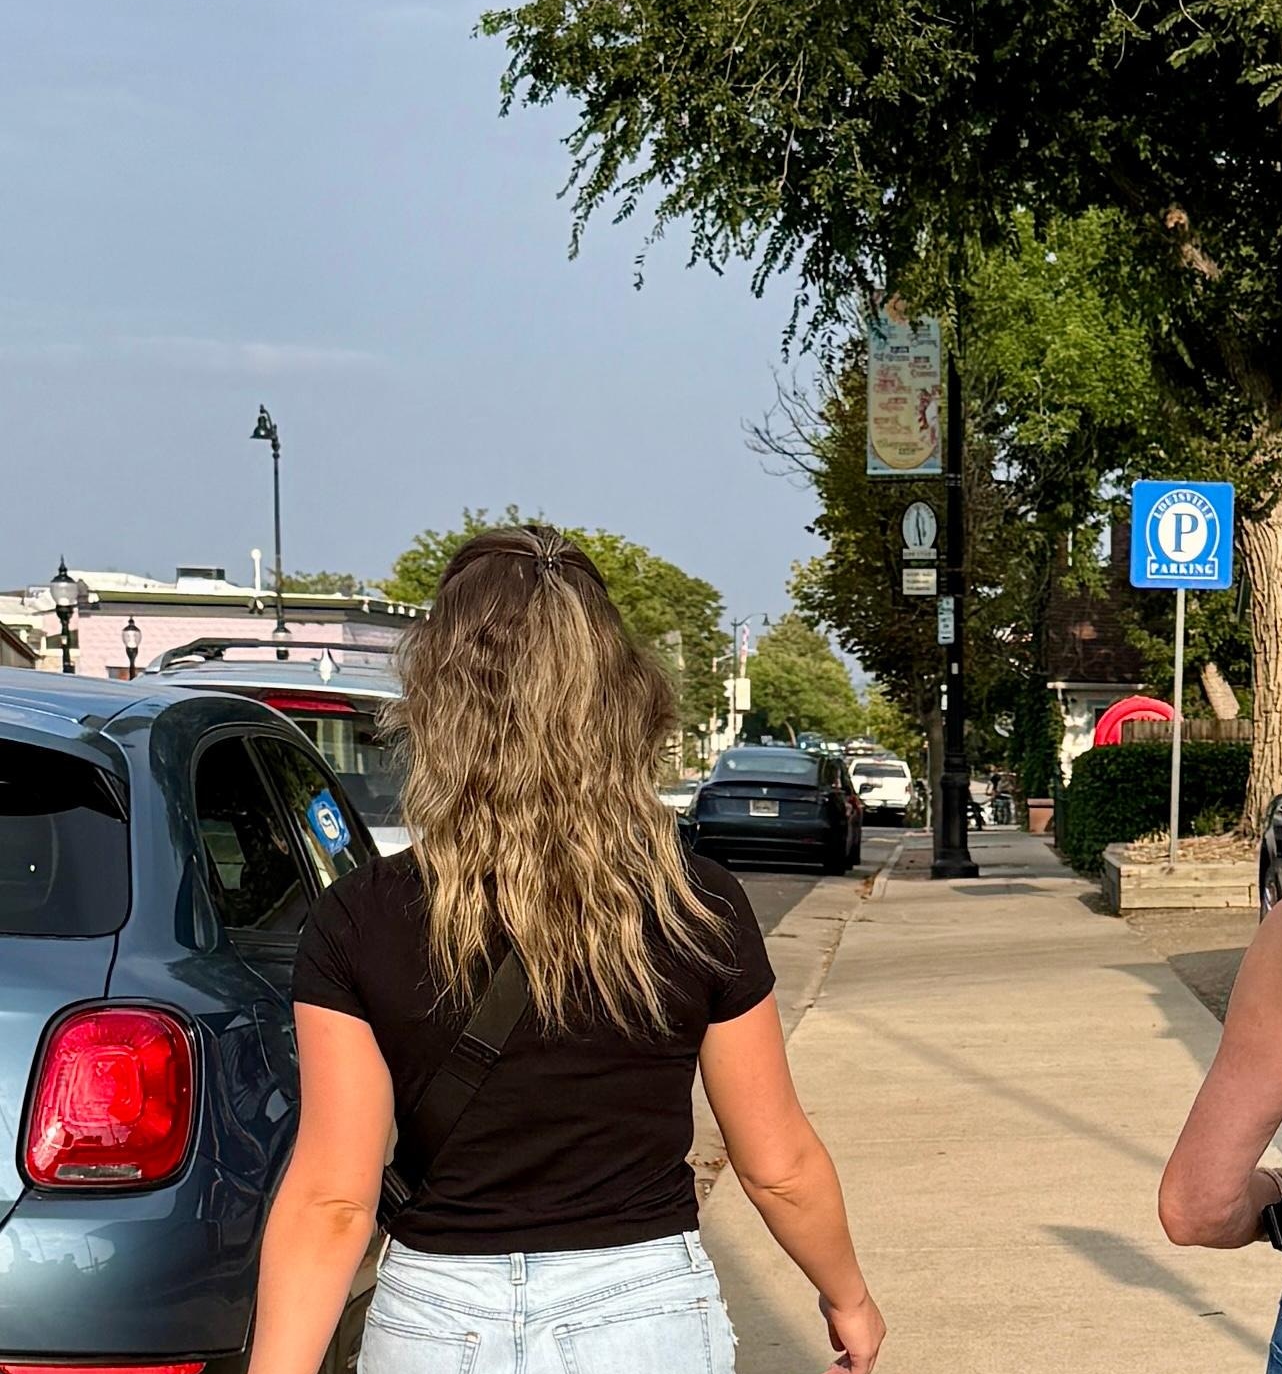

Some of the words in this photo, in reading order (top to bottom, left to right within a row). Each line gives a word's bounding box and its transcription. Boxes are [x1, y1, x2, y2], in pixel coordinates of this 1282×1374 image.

[1153, 492, 1214, 520] LOUISVILLE
[1172, 512, 1199, 553] P
[1150, 562, 1214, 575] PARKING
